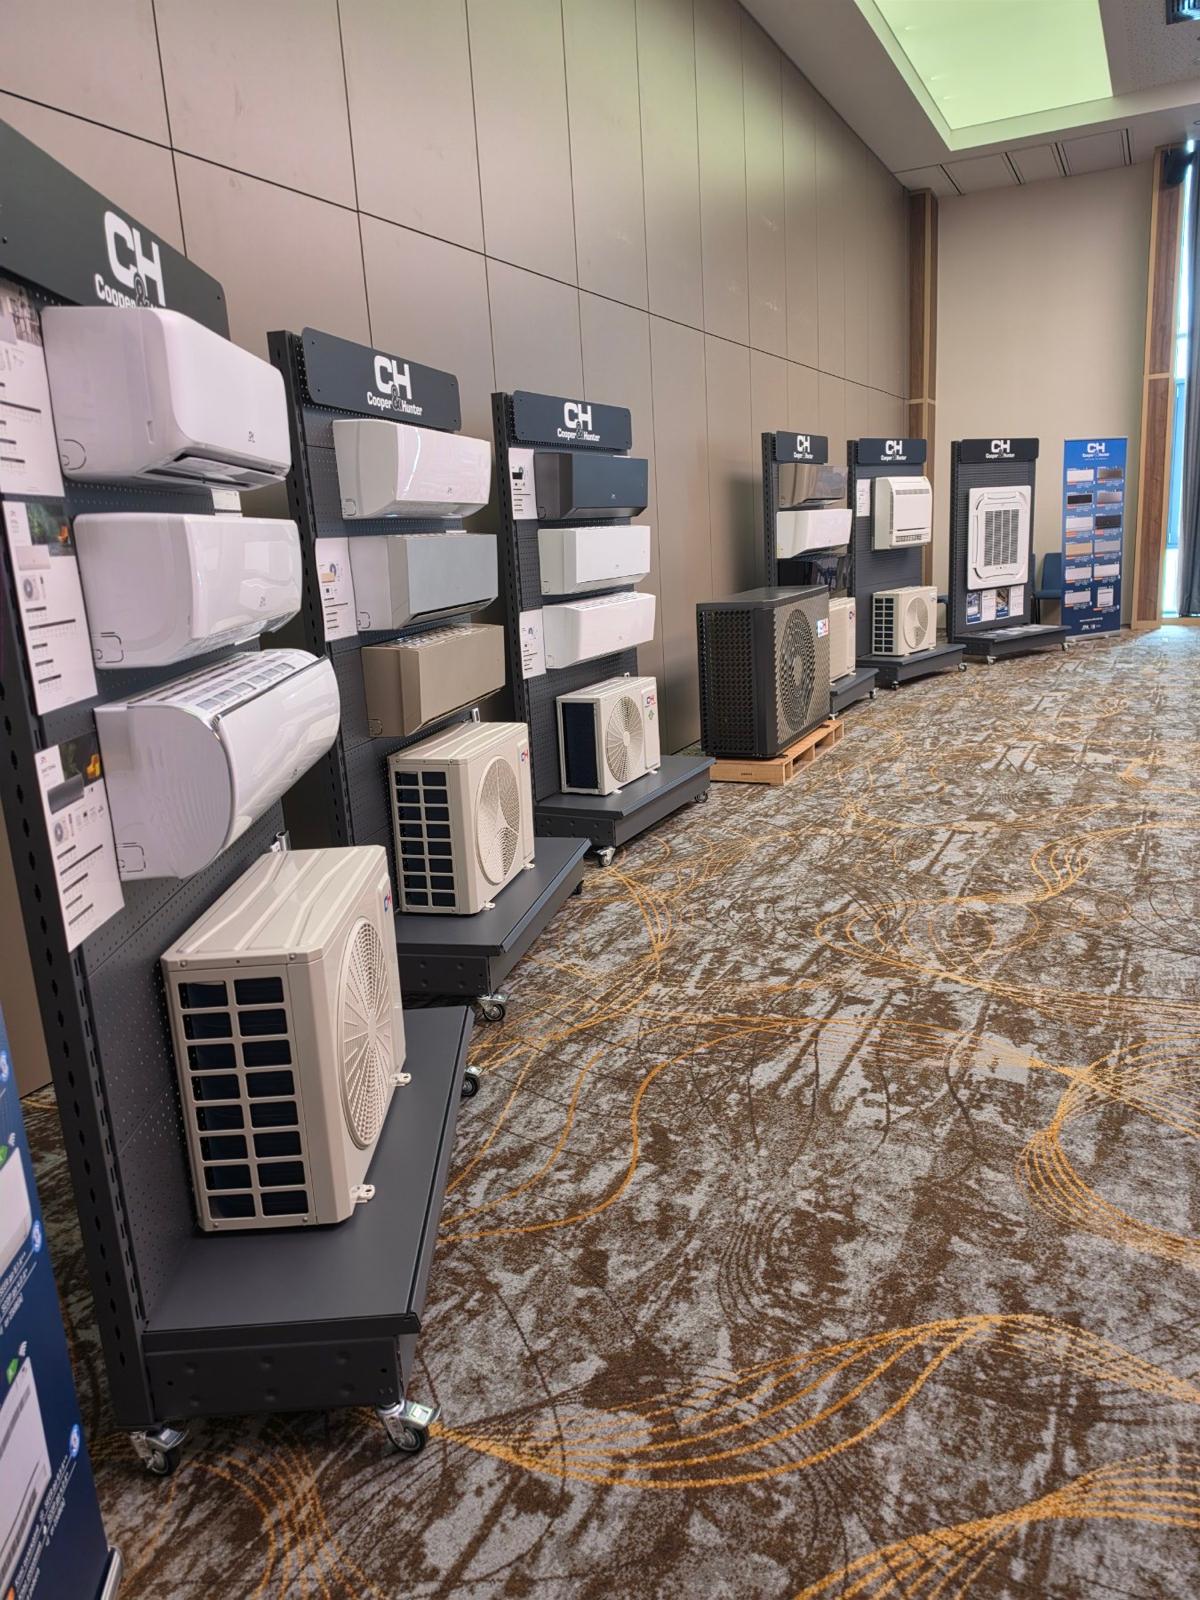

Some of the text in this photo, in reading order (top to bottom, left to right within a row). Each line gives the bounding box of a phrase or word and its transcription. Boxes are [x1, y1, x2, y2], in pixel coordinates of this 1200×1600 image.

[105, 211, 166, 307] CH
[374, 355, 412, 400] CH
[367, 391, 392, 411] Cooper
[402, 400, 423, 416] Hunter
[564, 402, 592, 431] CH
[557, 428, 576, 440] Cooper
[796, 435, 811, 453] CH
[885, 440, 903, 455] CH
[991, 440, 1011, 453] CH
[1087, 443, 1106, 453] CH
